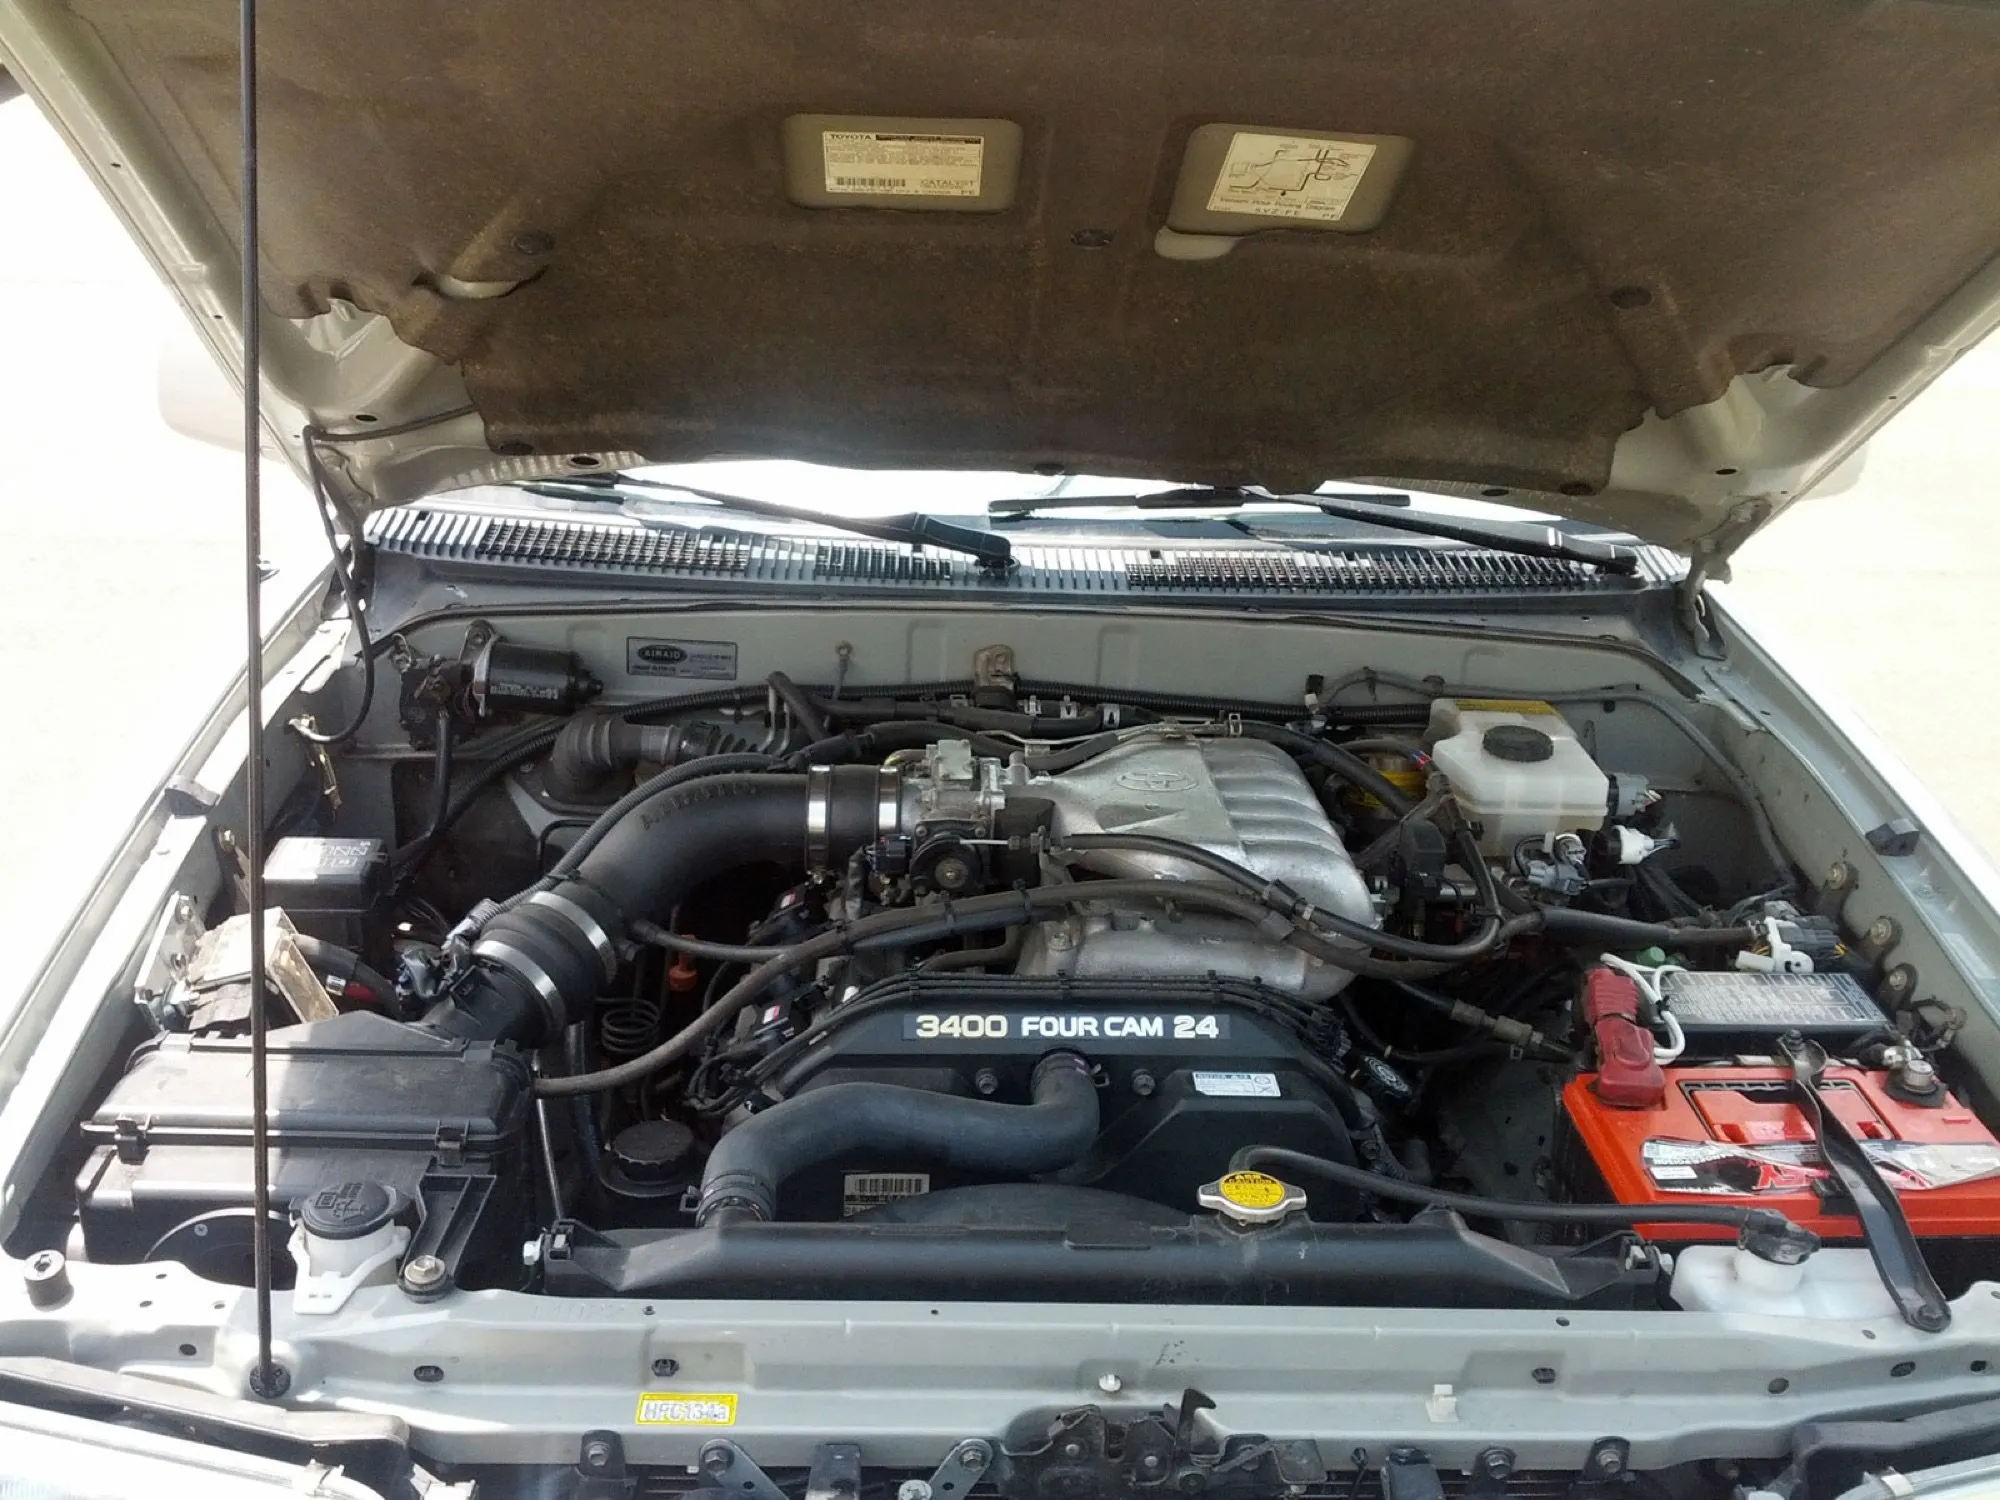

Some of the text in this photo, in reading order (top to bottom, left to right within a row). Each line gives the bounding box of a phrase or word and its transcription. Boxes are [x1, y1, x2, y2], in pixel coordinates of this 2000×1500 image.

[916, 1015, 1219, 1038] 3400 FOUR CAM 24
[644, 1403, 727, 1419] HFC134a
